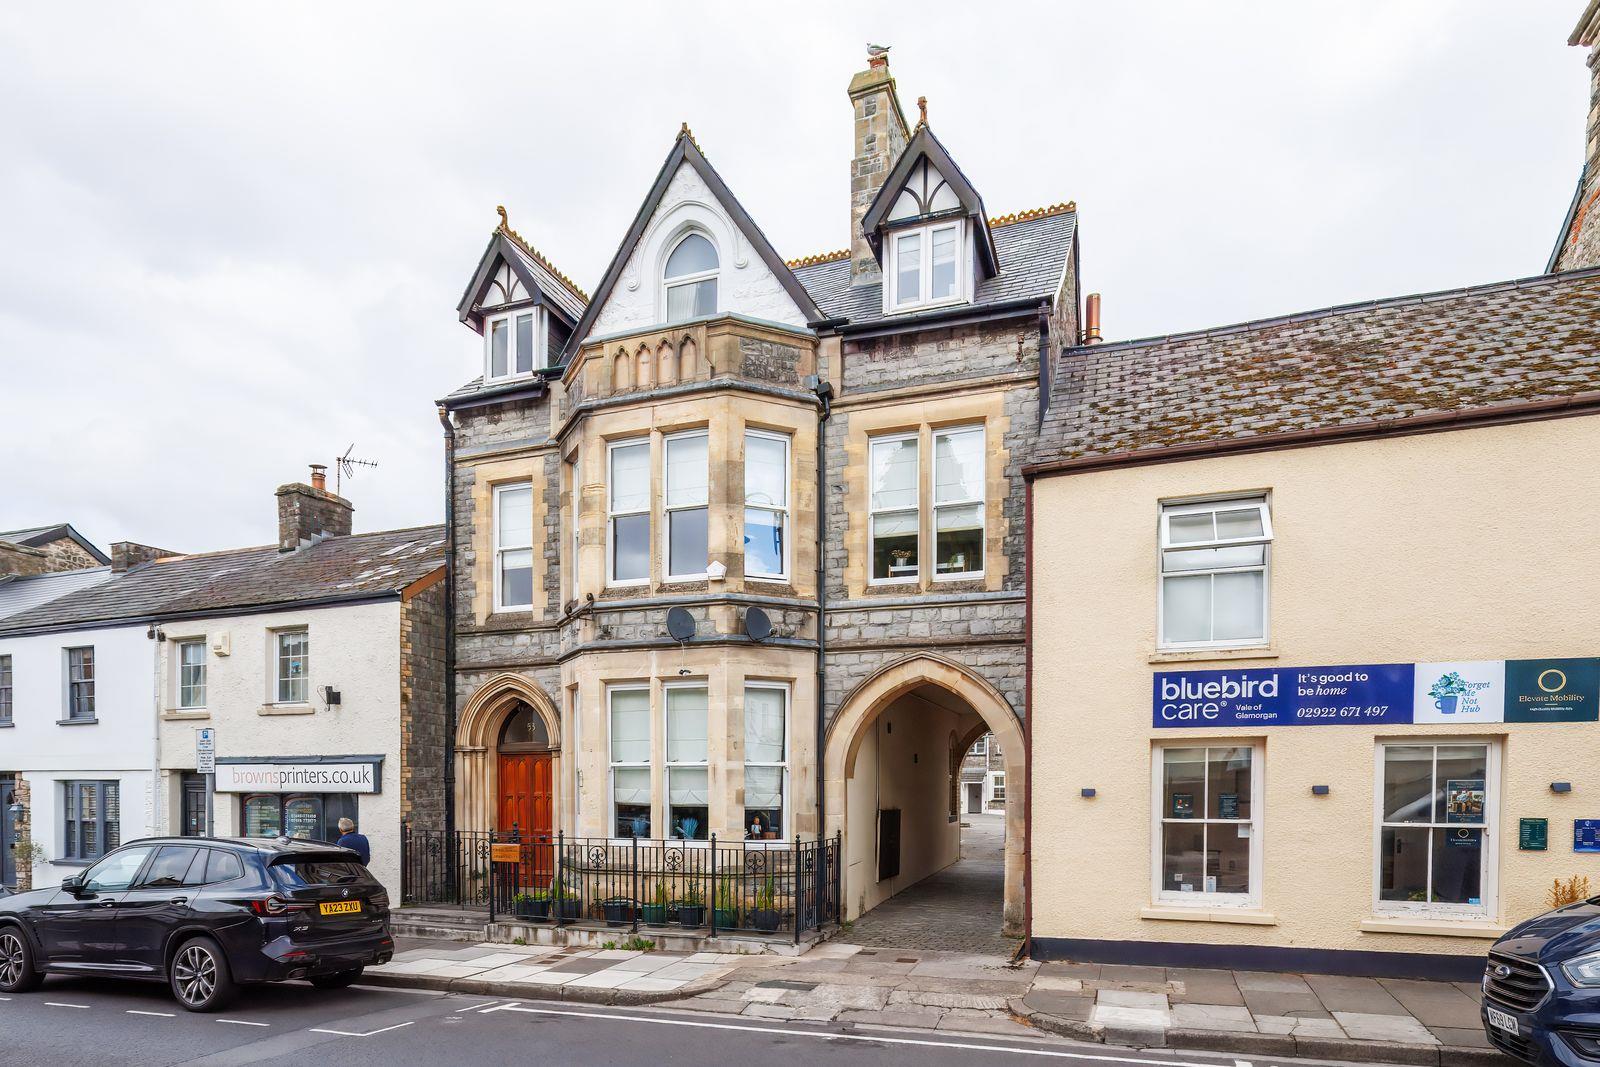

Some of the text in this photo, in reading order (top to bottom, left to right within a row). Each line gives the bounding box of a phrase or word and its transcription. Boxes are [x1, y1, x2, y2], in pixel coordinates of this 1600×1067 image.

[1298, 672, 1368, 684] It's good to
[1162, 674, 1278, 700] bluebird
[1298, 685, 1348, 696] be home
[1550, 694, 1584, 702] Mobility
[1236, 711, 1278, 720] Glamorgan
[1296, 706, 1388, 718] 02922 671 497
[232, 766, 370, 788] brownsprinters.co.uk
[323, 903, 343, 913] YA23
